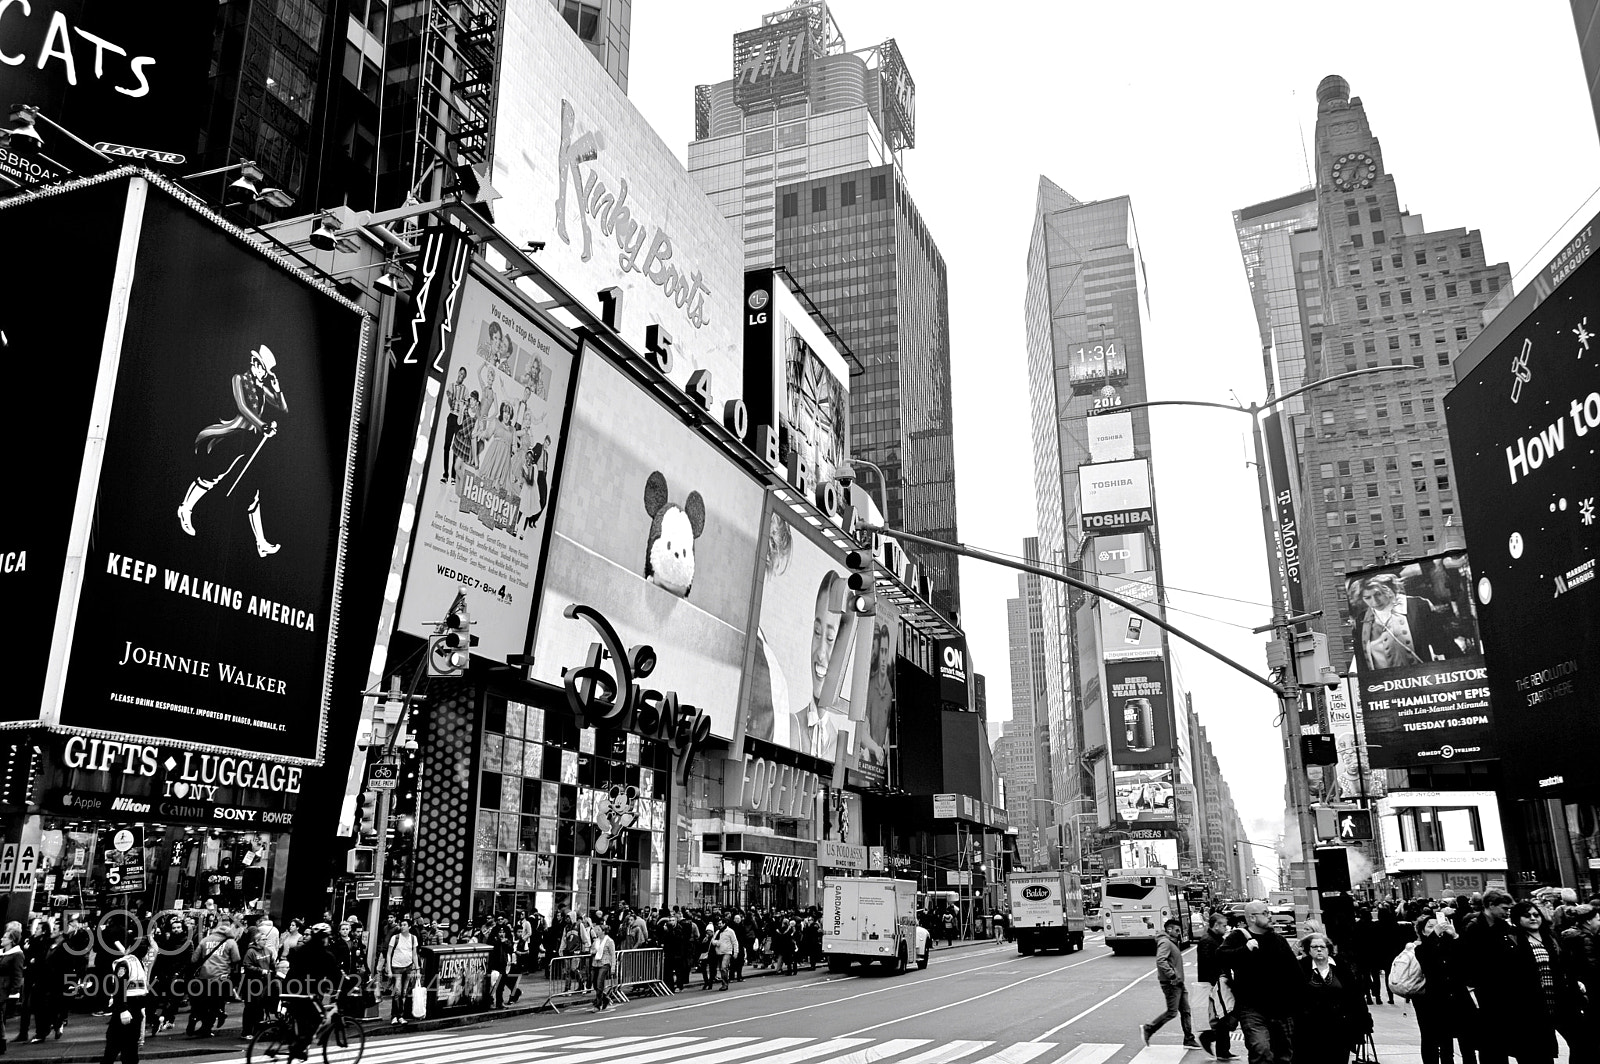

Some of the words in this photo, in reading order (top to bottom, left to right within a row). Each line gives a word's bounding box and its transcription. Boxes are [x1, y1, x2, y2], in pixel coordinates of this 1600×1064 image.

[0, 0, 155, 97] CATS
[738, 32, 805, 87] H&M
[101, 144, 177, 162] LAMAR
[556, 98, 646, 273] Kinky
[1551, 227, 1592, 273] MARRIOTT
[1553, 245, 1591, 286] MARQUIS
[643, 227, 711, 329] Boots
[491, 303, 501, 317] You
[502, 312, 514, 330] can't
[515, 324, 528, 342] stop
[528, 330, 537, 345] the
[537, 338, 550, 356] beat!
[750, 315, 767, 325] LG
[597, 286, 748, 440] 1540
[1077, 344, 1116, 363] 1:34
[1094, 397, 1121, 408] 2016
[1097, 434, 1123, 442] TOSHIBA
[1506, 416, 1565, 484] How
[1570, 391, 1600, 437] to
[1092, 479, 1133, 489] TOSHIBA
[464, 475, 517, 526] Hairspray
[1083, 511, 1151, 527] TOSHIBA
[1109, 550, 1130, 560] TD
[438, 564, 456, 579] WED
[457, 572, 473, 587] DEC
[474, 580, 480, 588] 7
[482, 583, 496, 594] 8PM
[1566, 559, 1595, 579] MARRIOTT
[1568, 571, 1594, 588] MARQUIS
[107, 552, 157, 584] KEEP
[164, 569, 242, 610] WALKING
[248, 596, 314, 632] AMERICA
[119, 641, 210, 678] JOHNNIE
[218, 663, 286, 695] WALKER
[944, 646, 962, 670] ON
[1112, 683, 1135, 691] WITH
[1383, 675, 1432, 692] DRUNK
[1434, 667, 1488, 685] HISTOR
[1515, 677, 1530, 691] THE
[1530, 659, 1578, 686] REVOLUTION
[1368, 700, 1390, 710] THE
[1464, 687, 1490, 699] EPIS
[1526, 687, 1553, 707] STARTS
[1553, 679, 1575, 698] HERE
[110, 693, 134, 704] PLEASE
[135, 697, 154, 708] DRINK
[155, 701, 195, 715] RESPONSIBLY.
[196, 708, 223, 720] IMPORTED
[1329, 701, 1346, 711] LION
[1330, 711, 1350, 722] KING
[1399, 708, 1413, 716] with
[1415, 703, 1455, 714] Lin-Manuel
[1457, 700, 1488, 710] Miranda
[1403, 720, 1445, 731] TUESDAY
[1447, 715, 1488, 727] 10:30PM
[63, 736, 158, 776] GIFTS
[181, 752, 302, 794] LUGGAGE
[164, 781, 171, 797] I
[188, 784, 219, 801] NY
[733, 753, 819, 821] FOREVER
[74, 796, 101, 809] Apple
[111, 797, 150, 813] Nikon
[159, 802, 204, 818] Canon
[214, 807, 257, 821] SONY
[263, 812, 293, 825] BOWER
[836, 845, 849, 858] POLO
[0, 846, 14, 884] ATM
[18, 846, 34, 884] ATM
[763, 856, 795, 877] FOREVER
[795, 860, 803, 877] 21
[1025, 888, 1049, 898] Baldor
[1450, 876, 1478, 888] 1515
[439, 958, 468, 979] JERSEY
[469, 957, 487, 975] BOYS
